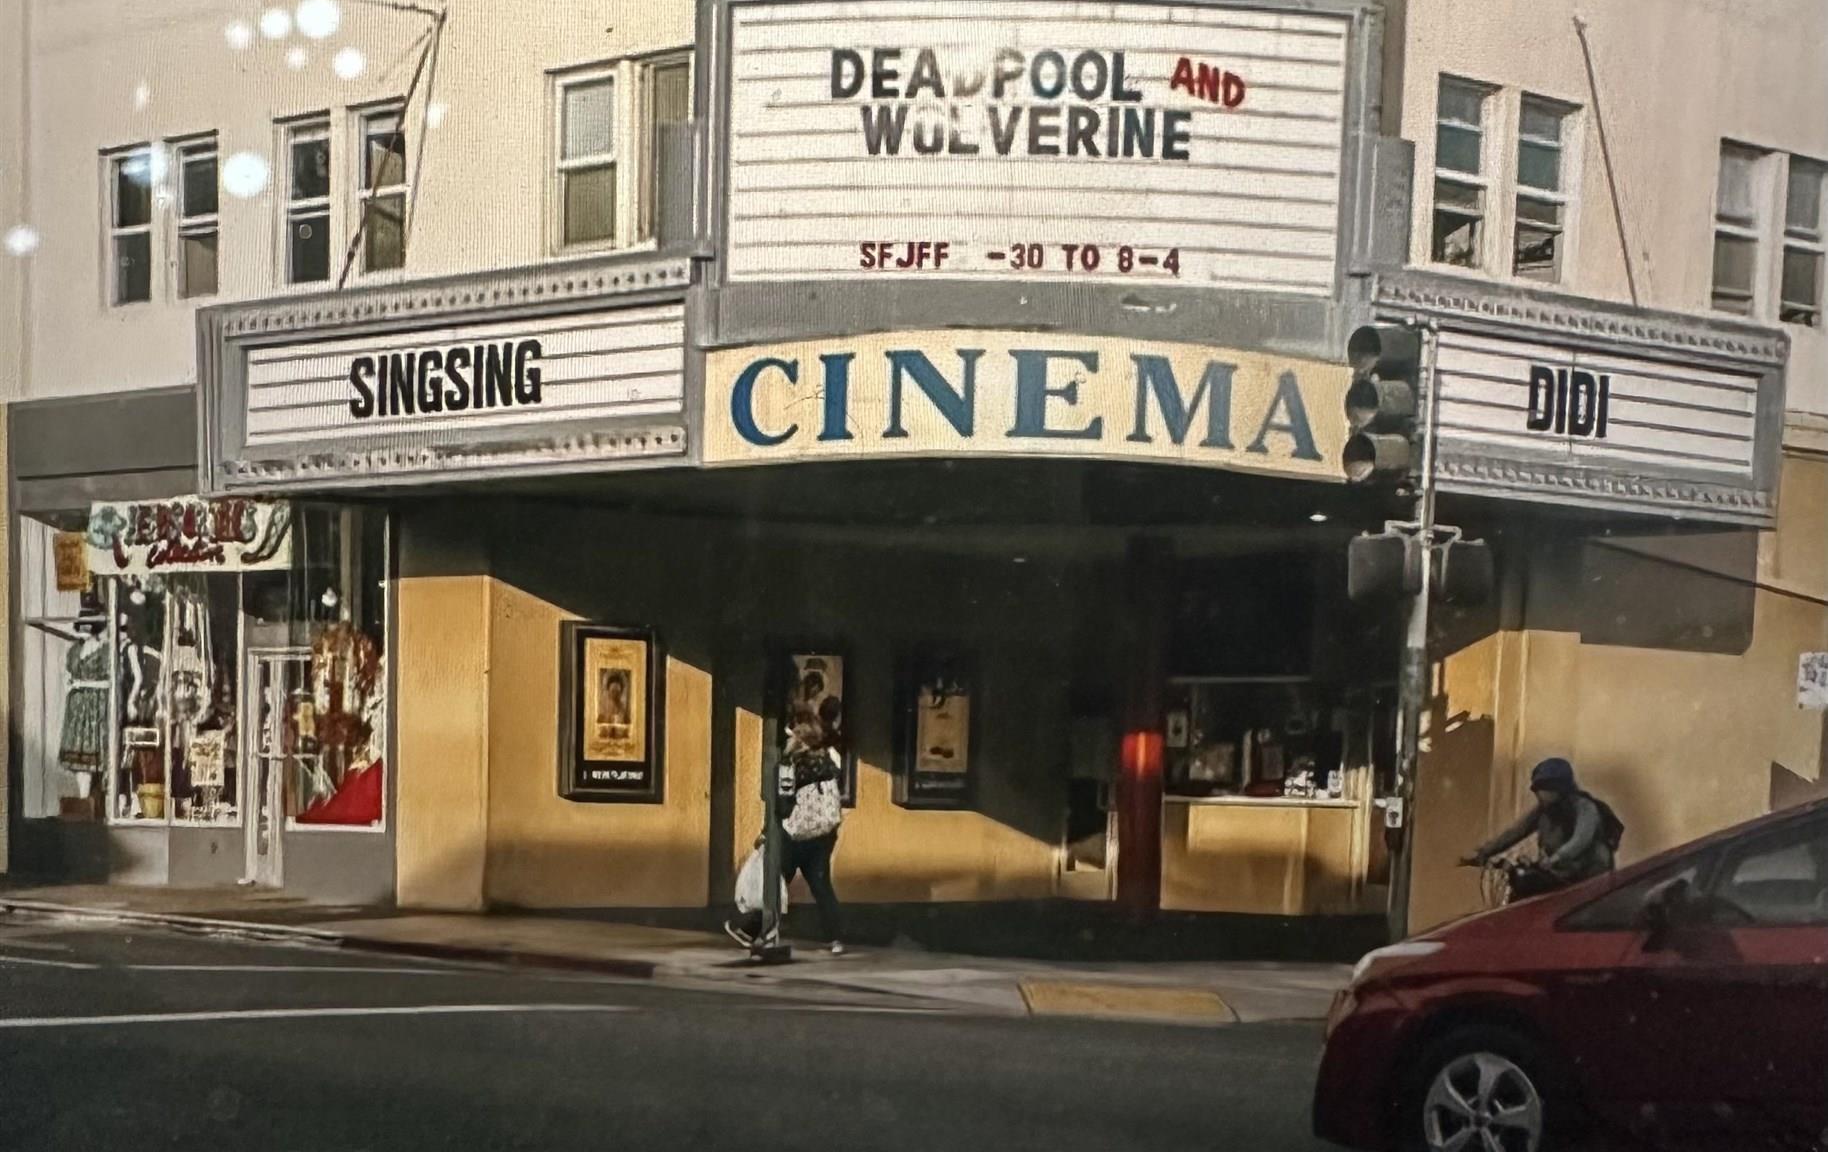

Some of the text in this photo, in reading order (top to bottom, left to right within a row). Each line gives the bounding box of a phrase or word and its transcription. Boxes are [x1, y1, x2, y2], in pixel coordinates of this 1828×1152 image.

[831, 47, 1246, 109] DEADPOOL AND
[860, 104, 1192, 161] WOLVERINE
[859, 241, 949, 270] SFJFF
[1061, 244, 1100, 272] TO
[1117, 245, 1180, 277] 8-4
[350, 339, 542, 419] SINGSING
[730, 348, 1323, 461] CINEMA
[1526, 364, 1611, 439] DIDI
